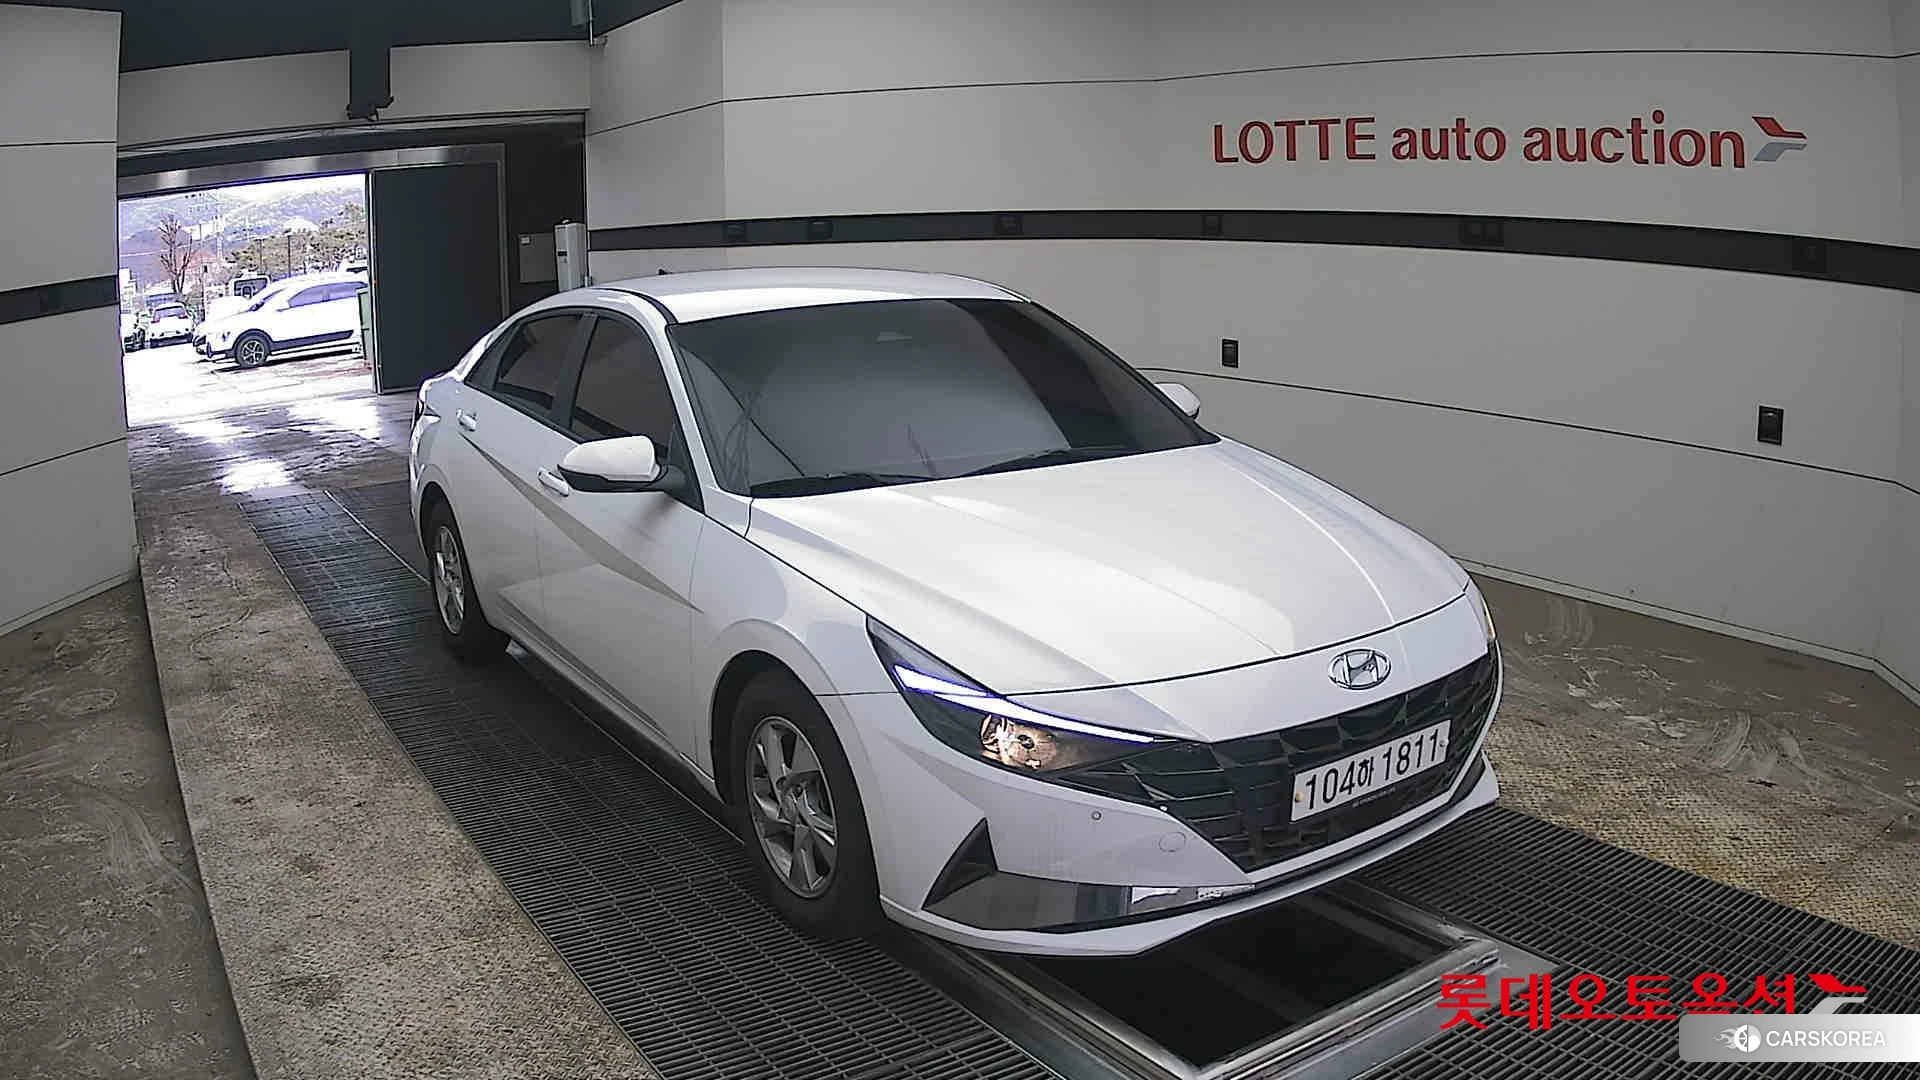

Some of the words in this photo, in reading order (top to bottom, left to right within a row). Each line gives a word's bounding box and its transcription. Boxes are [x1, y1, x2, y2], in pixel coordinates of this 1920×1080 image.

[1213, 116, 1377, 164] LOTTE
[1392, 117, 1507, 162] auto
[1523, 110, 1746, 169] auction
[1305, 756, 1375, 810] 104하
[1382, 728, 1440, 781] 1811
